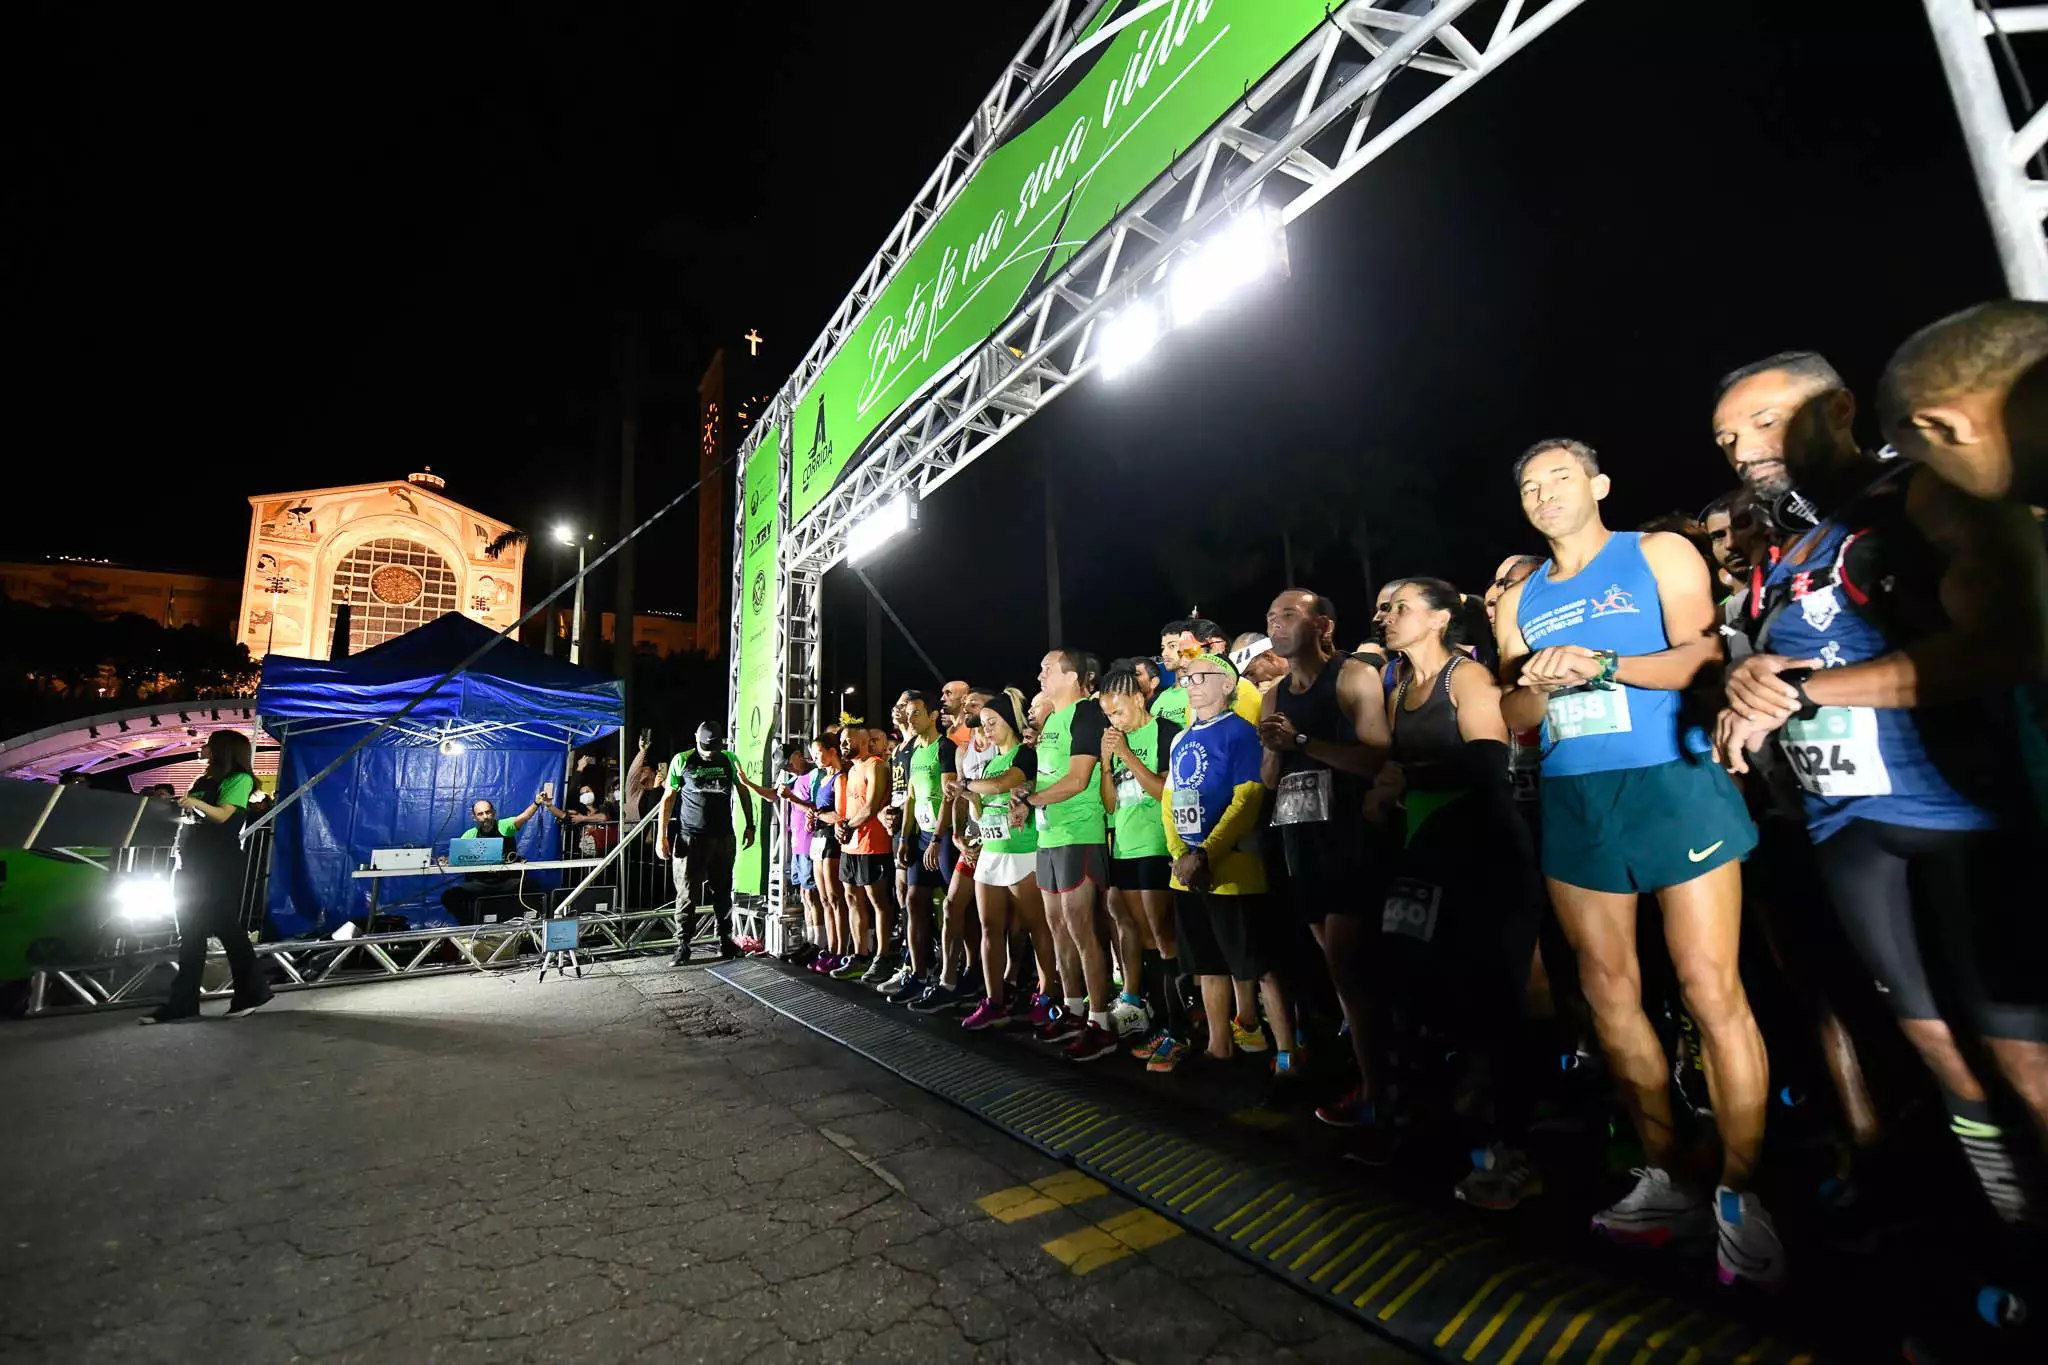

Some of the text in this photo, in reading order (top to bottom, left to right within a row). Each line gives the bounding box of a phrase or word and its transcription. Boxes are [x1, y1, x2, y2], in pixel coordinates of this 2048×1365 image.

[857, 280, 934, 413] Bote
[923, 246, 958, 362] fé
[962, 209, 1010, 285] na
[1015, 116, 1093, 228] sua
[802, 440, 833, 485] CORRIDA
